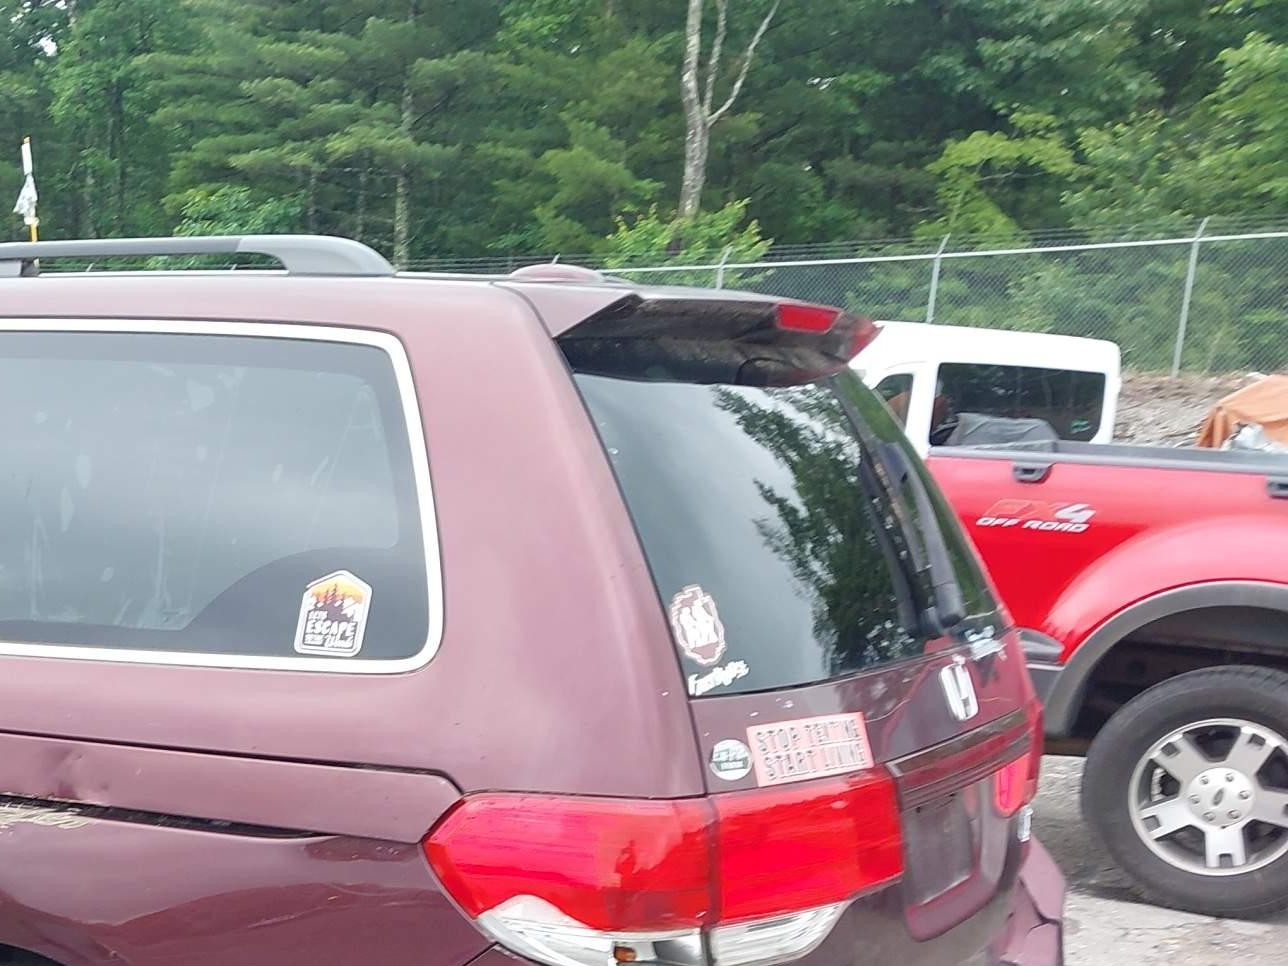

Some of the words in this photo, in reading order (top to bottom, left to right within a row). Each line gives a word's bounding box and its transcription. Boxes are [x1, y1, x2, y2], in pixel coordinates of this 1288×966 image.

[976, 516, 1022, 528] OFF
[1022, 519, 1091, 533] ROAD
[305, 619, 357, 638] ESCAPE
[755, 726, 800, 755] STOP
[763, 749, 818, 781] START
